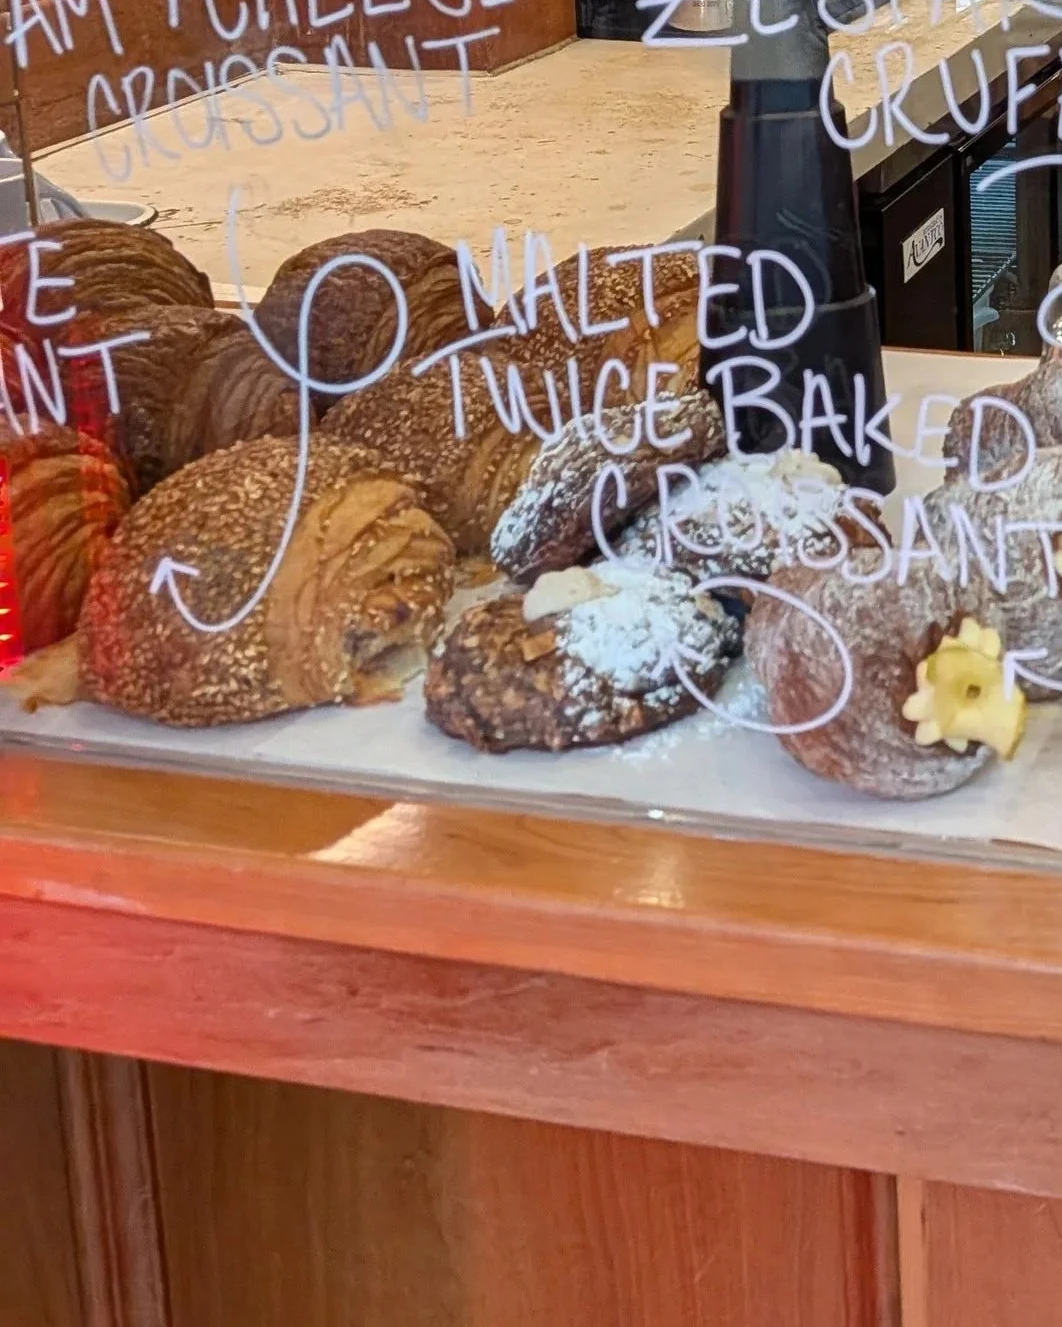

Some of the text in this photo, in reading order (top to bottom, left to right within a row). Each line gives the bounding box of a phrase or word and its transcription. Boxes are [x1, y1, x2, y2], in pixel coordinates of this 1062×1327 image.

[87, 26, 502, 183] CROISSANT
[455, 225, 816, 351] MALTED
[413, 324, 1036, 492] TWICE BAKED
